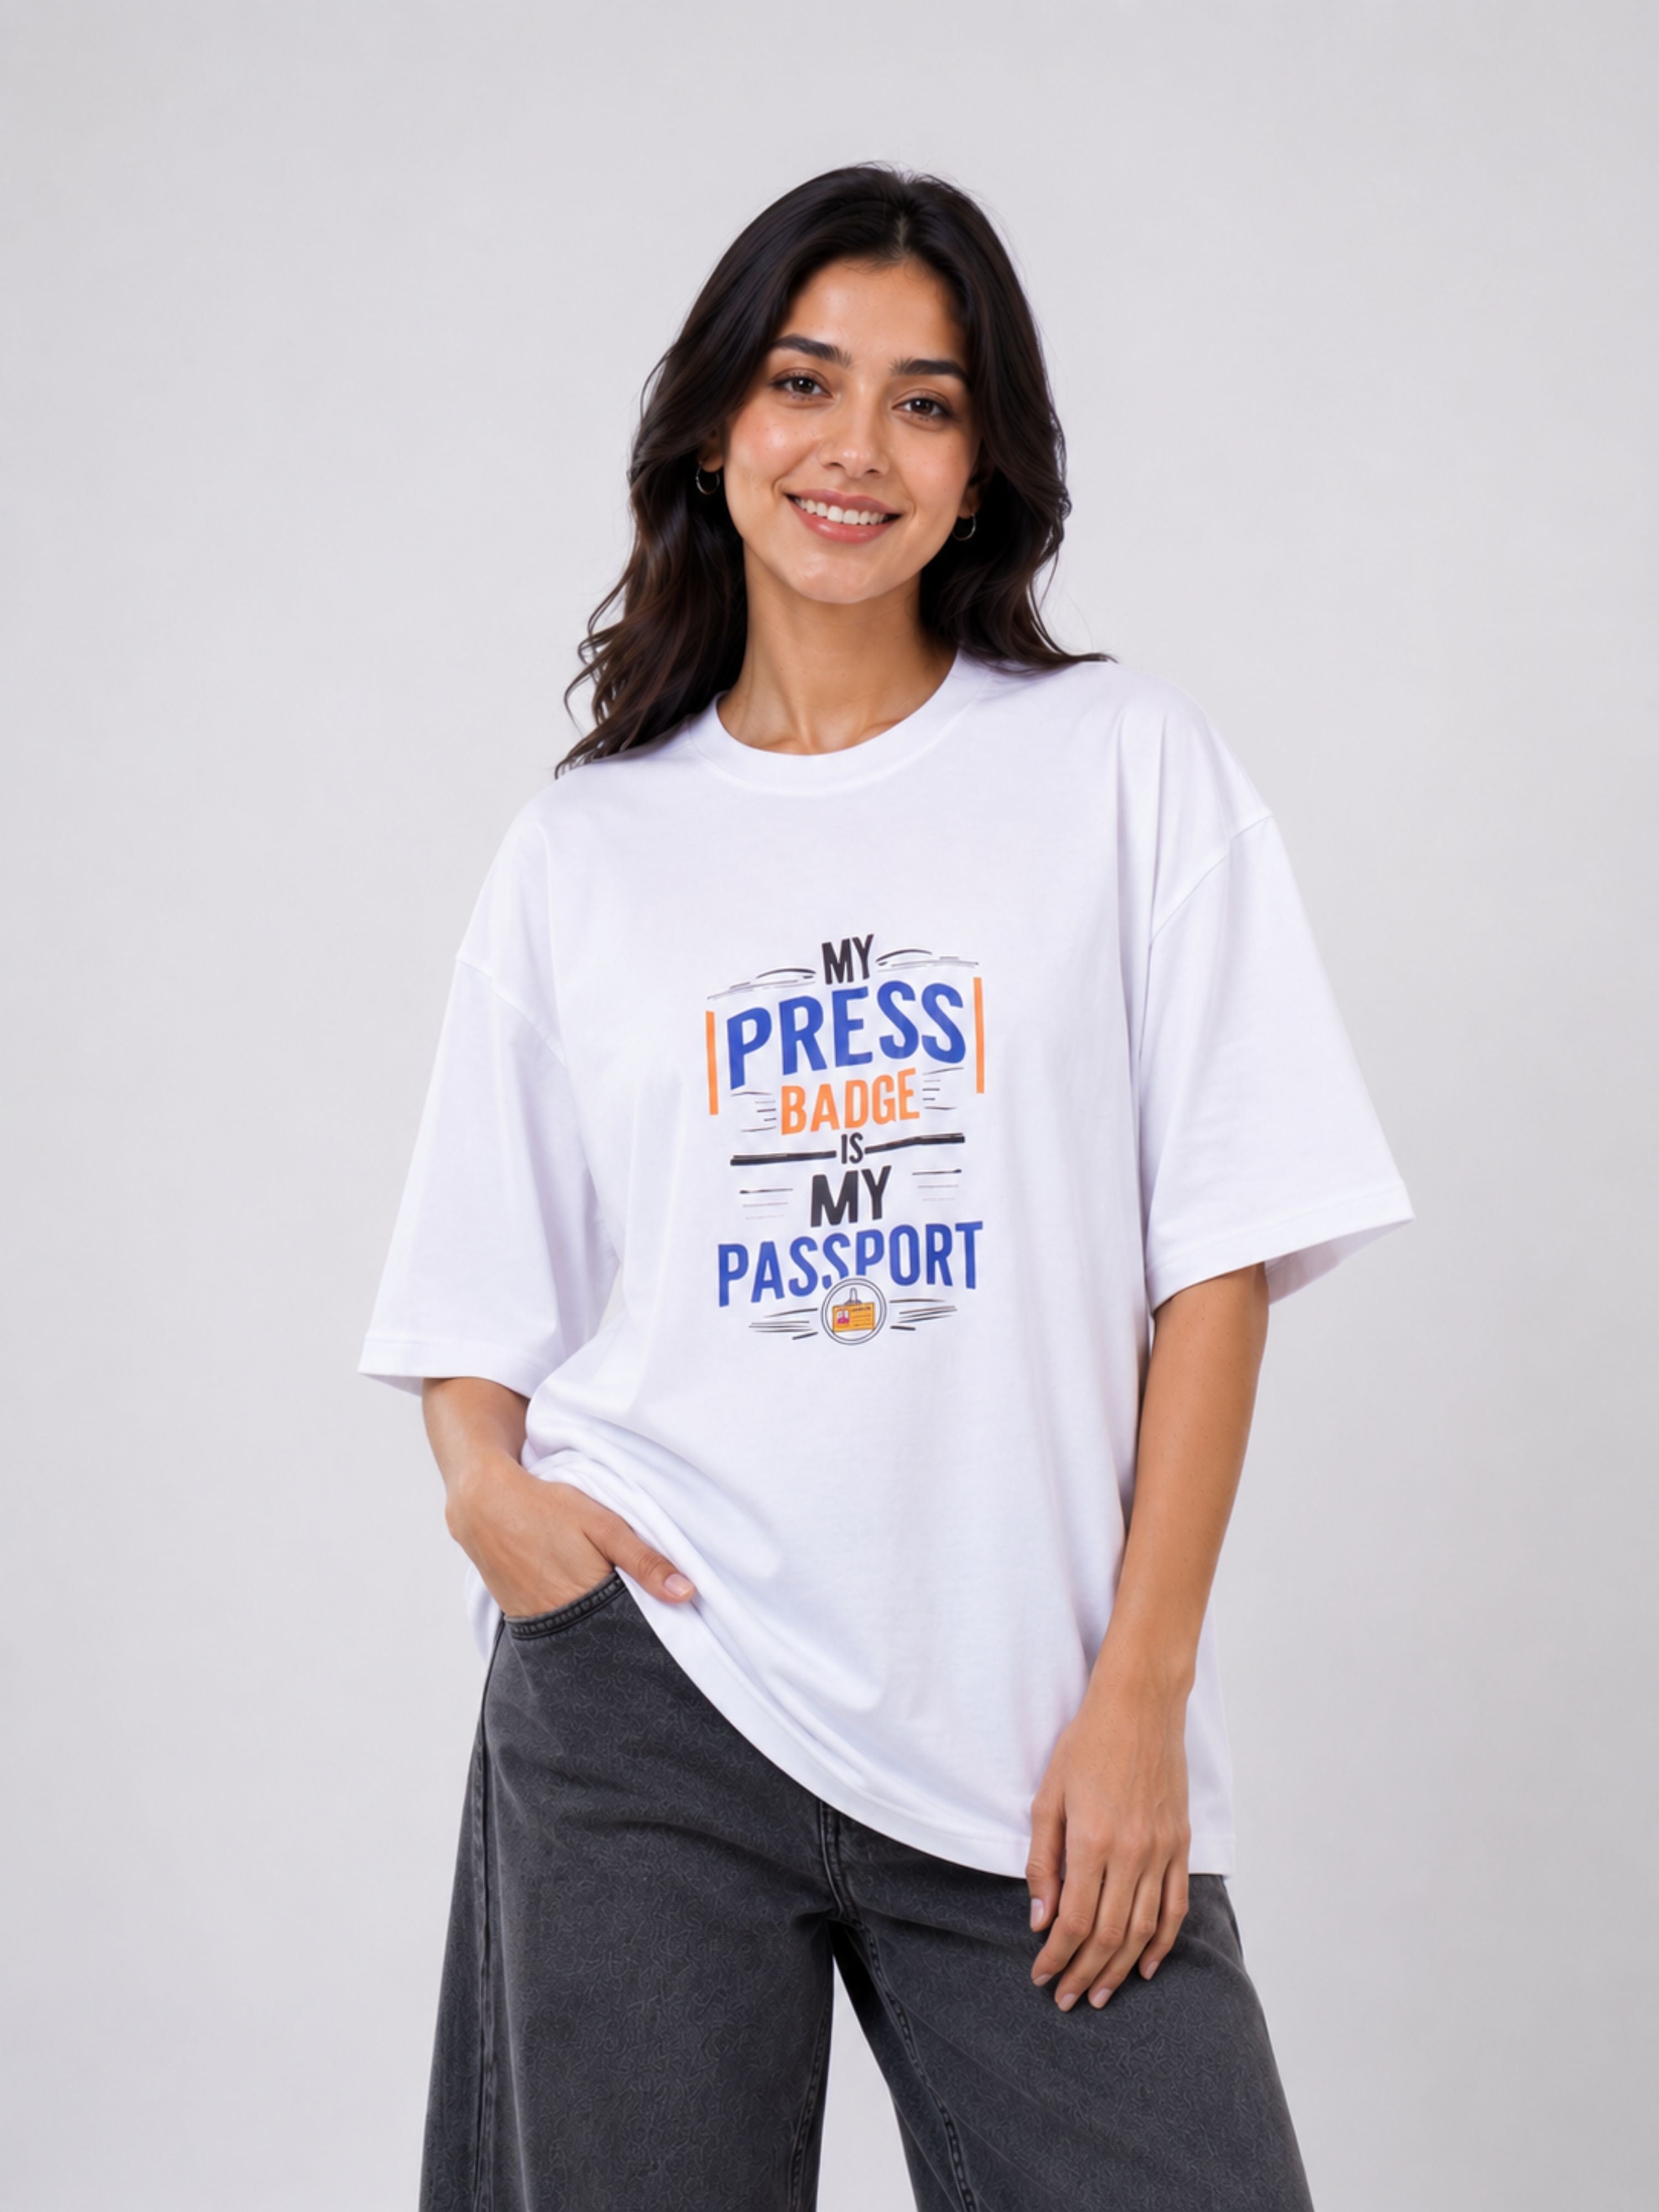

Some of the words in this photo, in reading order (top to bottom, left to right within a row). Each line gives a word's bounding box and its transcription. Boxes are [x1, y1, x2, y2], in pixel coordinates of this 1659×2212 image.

[822, 935, 874, 985] MY
[727, 980, 966, 1090] PRESS
[781, 1068, 920, 1135] BADGE
[841, 1133, 863, 1164] IS
[810, 1165, 891, 1227] MY
[718, 1221, 983, 1307] PASSPORT
